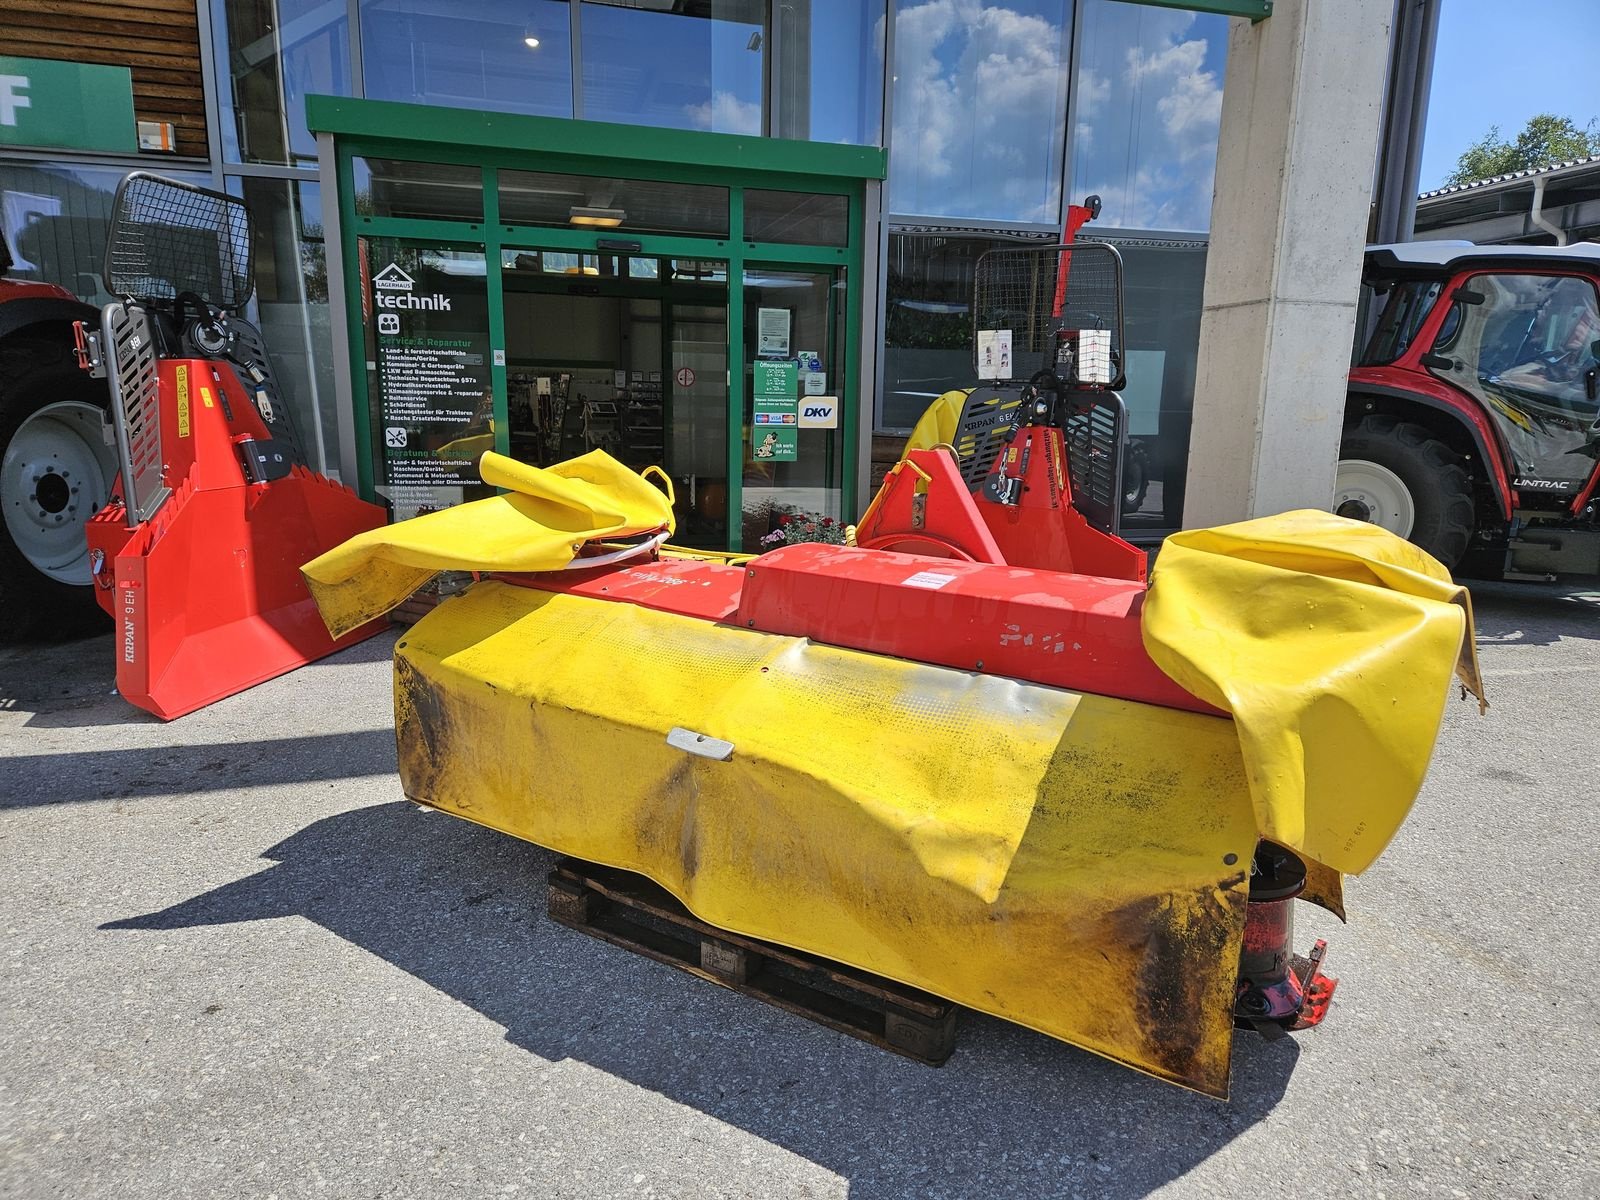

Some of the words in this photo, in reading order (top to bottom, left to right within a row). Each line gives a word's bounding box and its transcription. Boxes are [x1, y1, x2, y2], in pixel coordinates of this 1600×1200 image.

[375, 291, 451, 311] technik
[380, 336, 414, 346] Service
[417, 337, 424, 346] &
[427, 338, 472, 348] Reparatur
[410, 348, 466, 356] forstwirtschaftliche
[386, 354, 438, 362] Maschinen/Geräte
[760, 361, 793, 369] Öffnungszeiten
[420, 375, 460, 383] Begutachtung
[388, 381, 451, 389] Hydraulikservicestelle
[388, 388, 447, 396] Klimaanlagenservice
[389, 408, 434, 416] Leistungstester
[803, 407, 833, 418] DKV
[999, 415, 1005, 423] 6
[387, 449, 429, 458] Beratung
[1513, 478, 1570, 489] LINTRAC
[125, 590, 135, 605] EH
[125, 617, 134, 663] KRPAN
